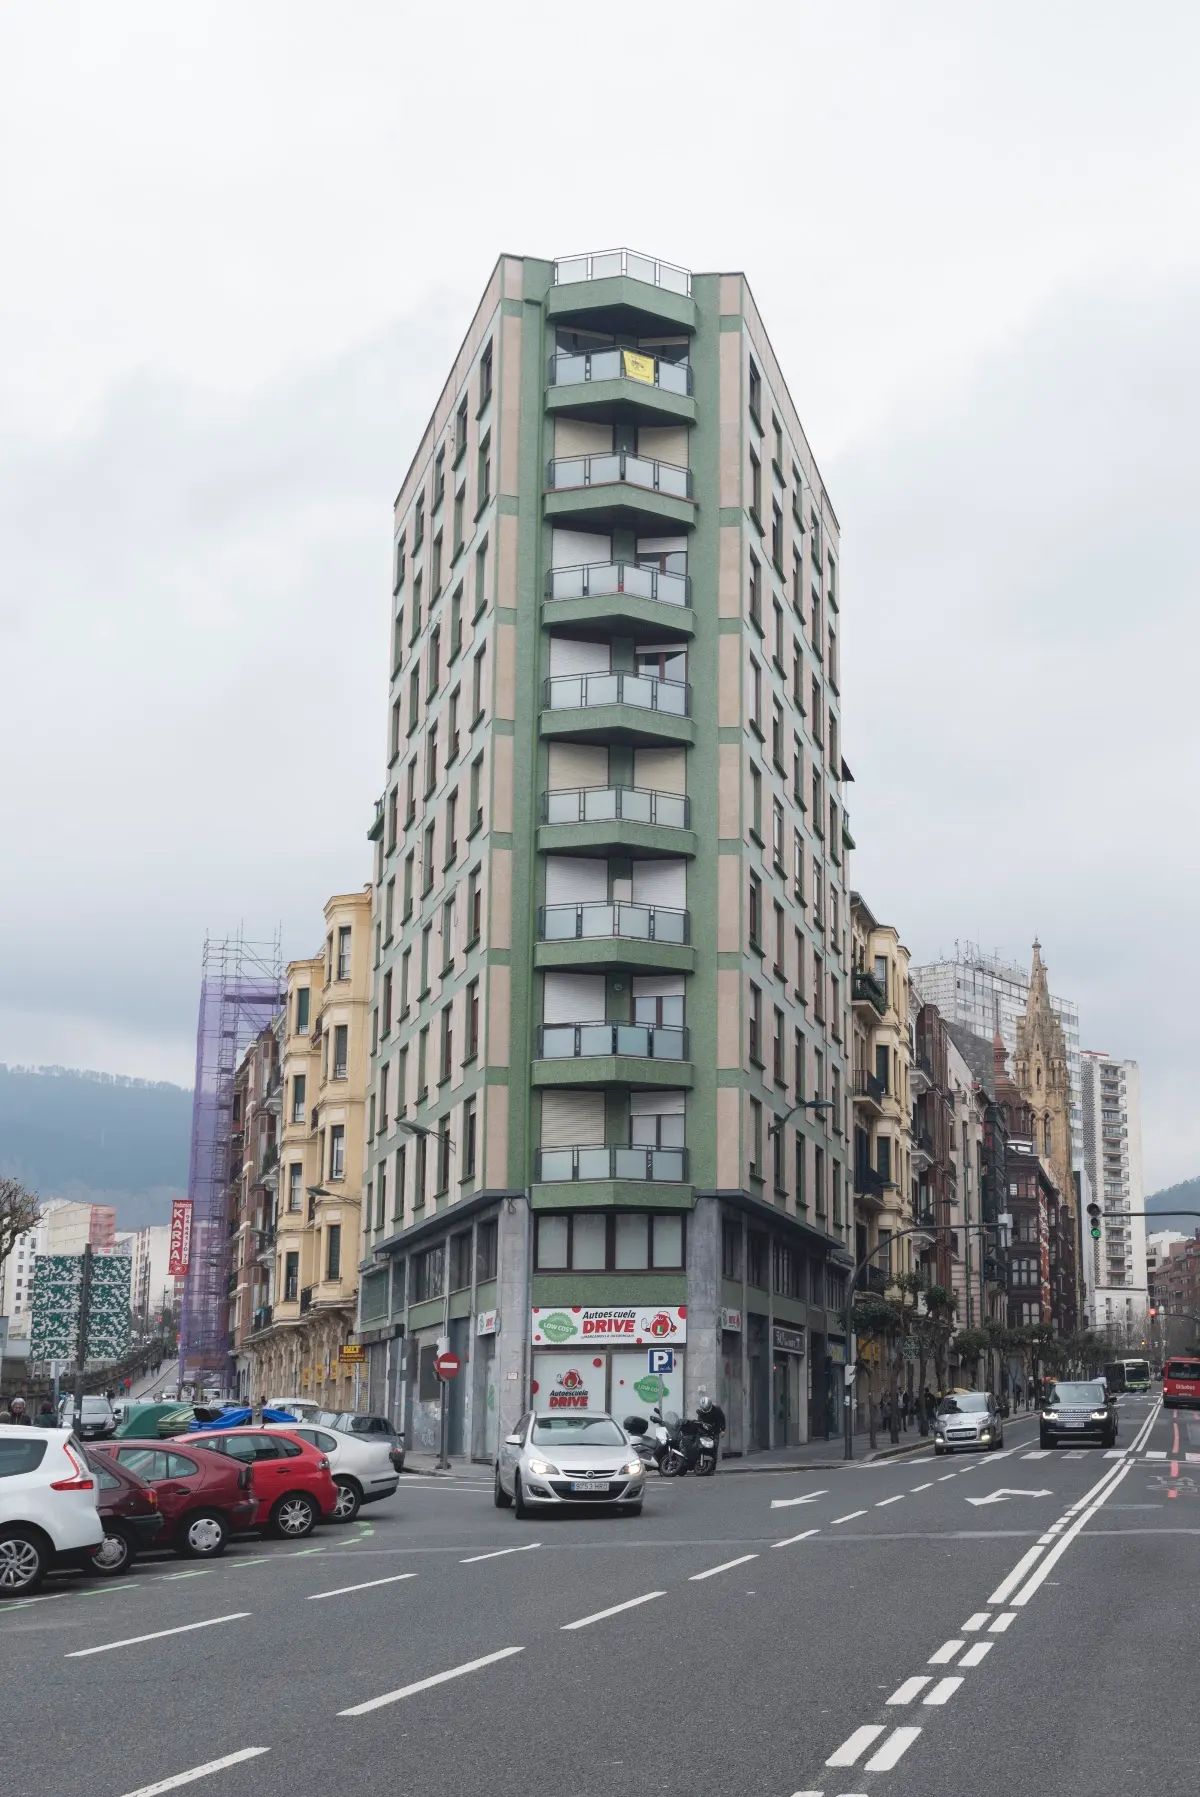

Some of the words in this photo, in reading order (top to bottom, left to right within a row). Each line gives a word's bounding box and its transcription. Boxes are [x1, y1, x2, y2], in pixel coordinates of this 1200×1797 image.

[170, 1208, 183, 1260] KARPA
[544, 1322, 557, 1330] LOW
[557, 1325, 574, 1334] COST
[582, 1319, 636, 1334] DRIVE
[654, 1352, 668, 1371] P
[549, 1396, 588, 1407] DRIVE
